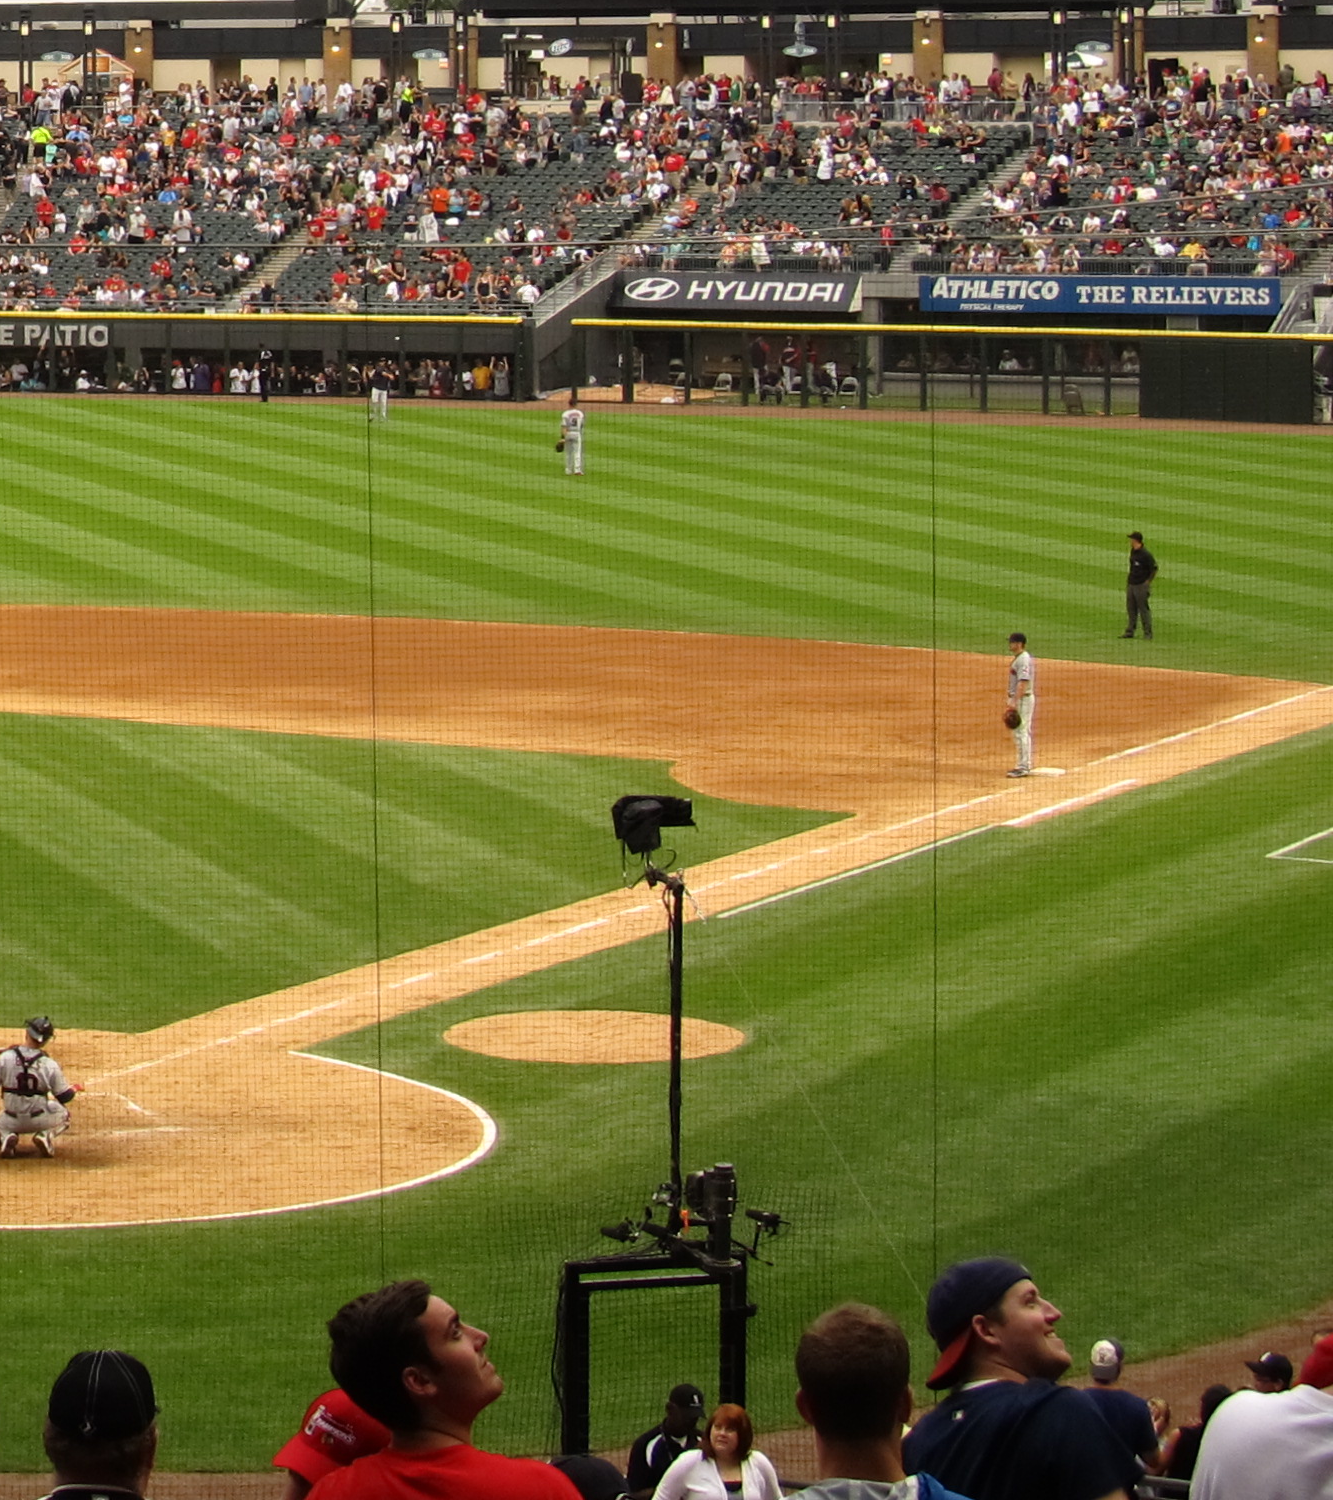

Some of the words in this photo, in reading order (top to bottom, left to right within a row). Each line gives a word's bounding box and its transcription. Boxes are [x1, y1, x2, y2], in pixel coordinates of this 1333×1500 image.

[687, 280, 845, 303] HYUNDAI
[932, 276, 1060, 300] ATHLETICO
[1076, 285, 1126, 304] THE
[1132, 286, 1270, 306] RELIEVERS
[23, 324, 109, 348] PATIO
